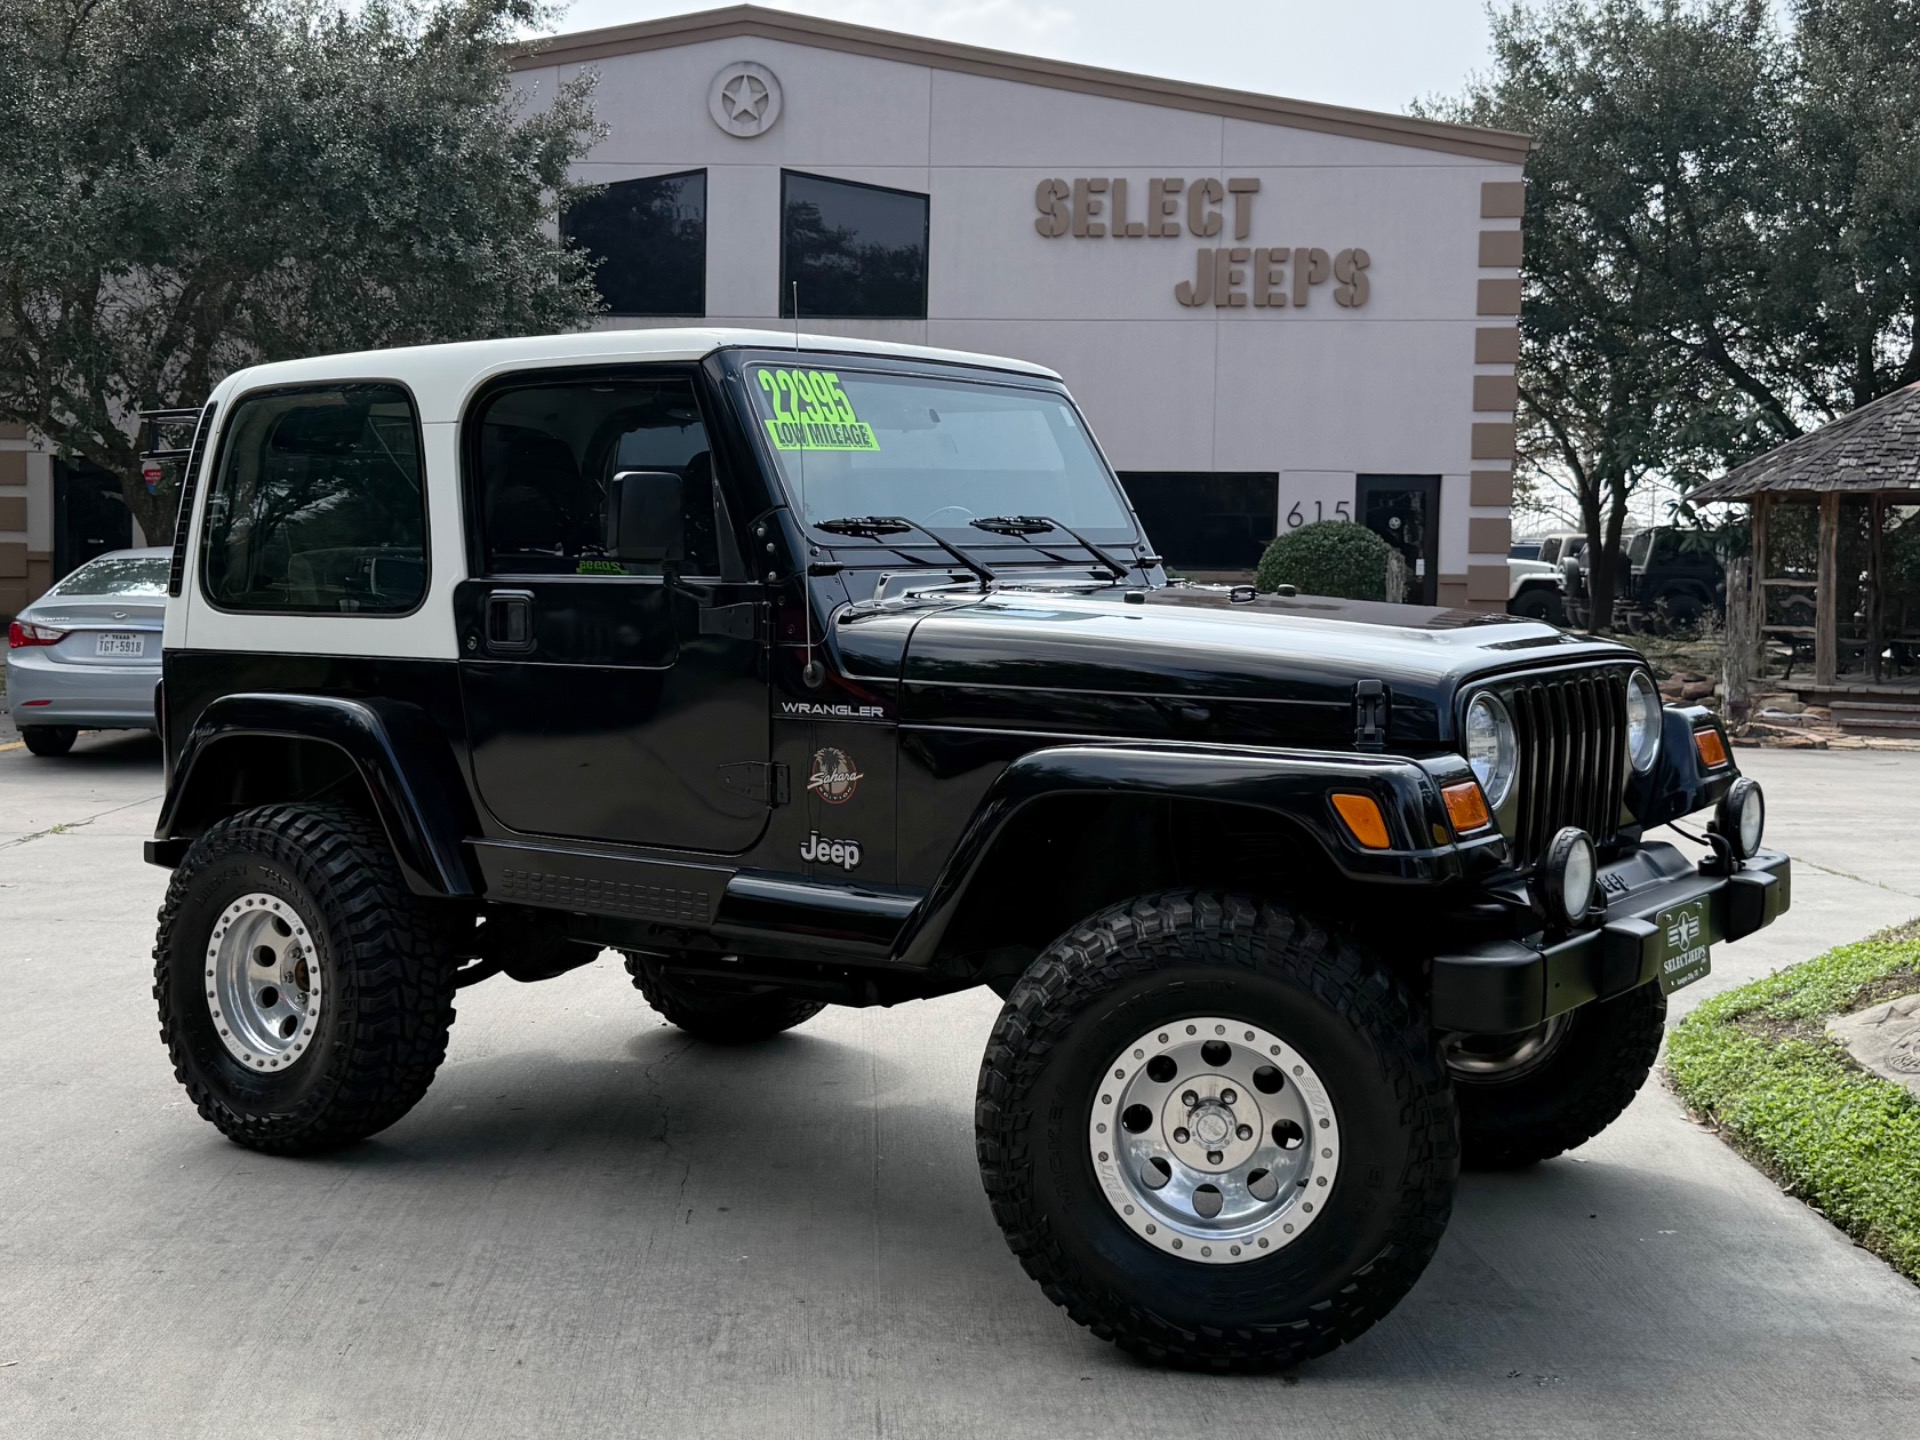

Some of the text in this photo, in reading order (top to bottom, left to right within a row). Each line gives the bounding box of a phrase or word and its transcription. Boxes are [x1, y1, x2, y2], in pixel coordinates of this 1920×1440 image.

[1035, 178, 1260, 240] SELECT
[1174, 248, 1370, 307] JEEPS
[758, 369, 856, 422] 22995
[773, 422, 872, 447] LOW MILEAGE
[1287, 501, 1350, 528] 615
[782, 702, 884, 718] WRANGLER
[807, 767, 864, 789] Sahara
[800, 830, 861, 870] Jeep
